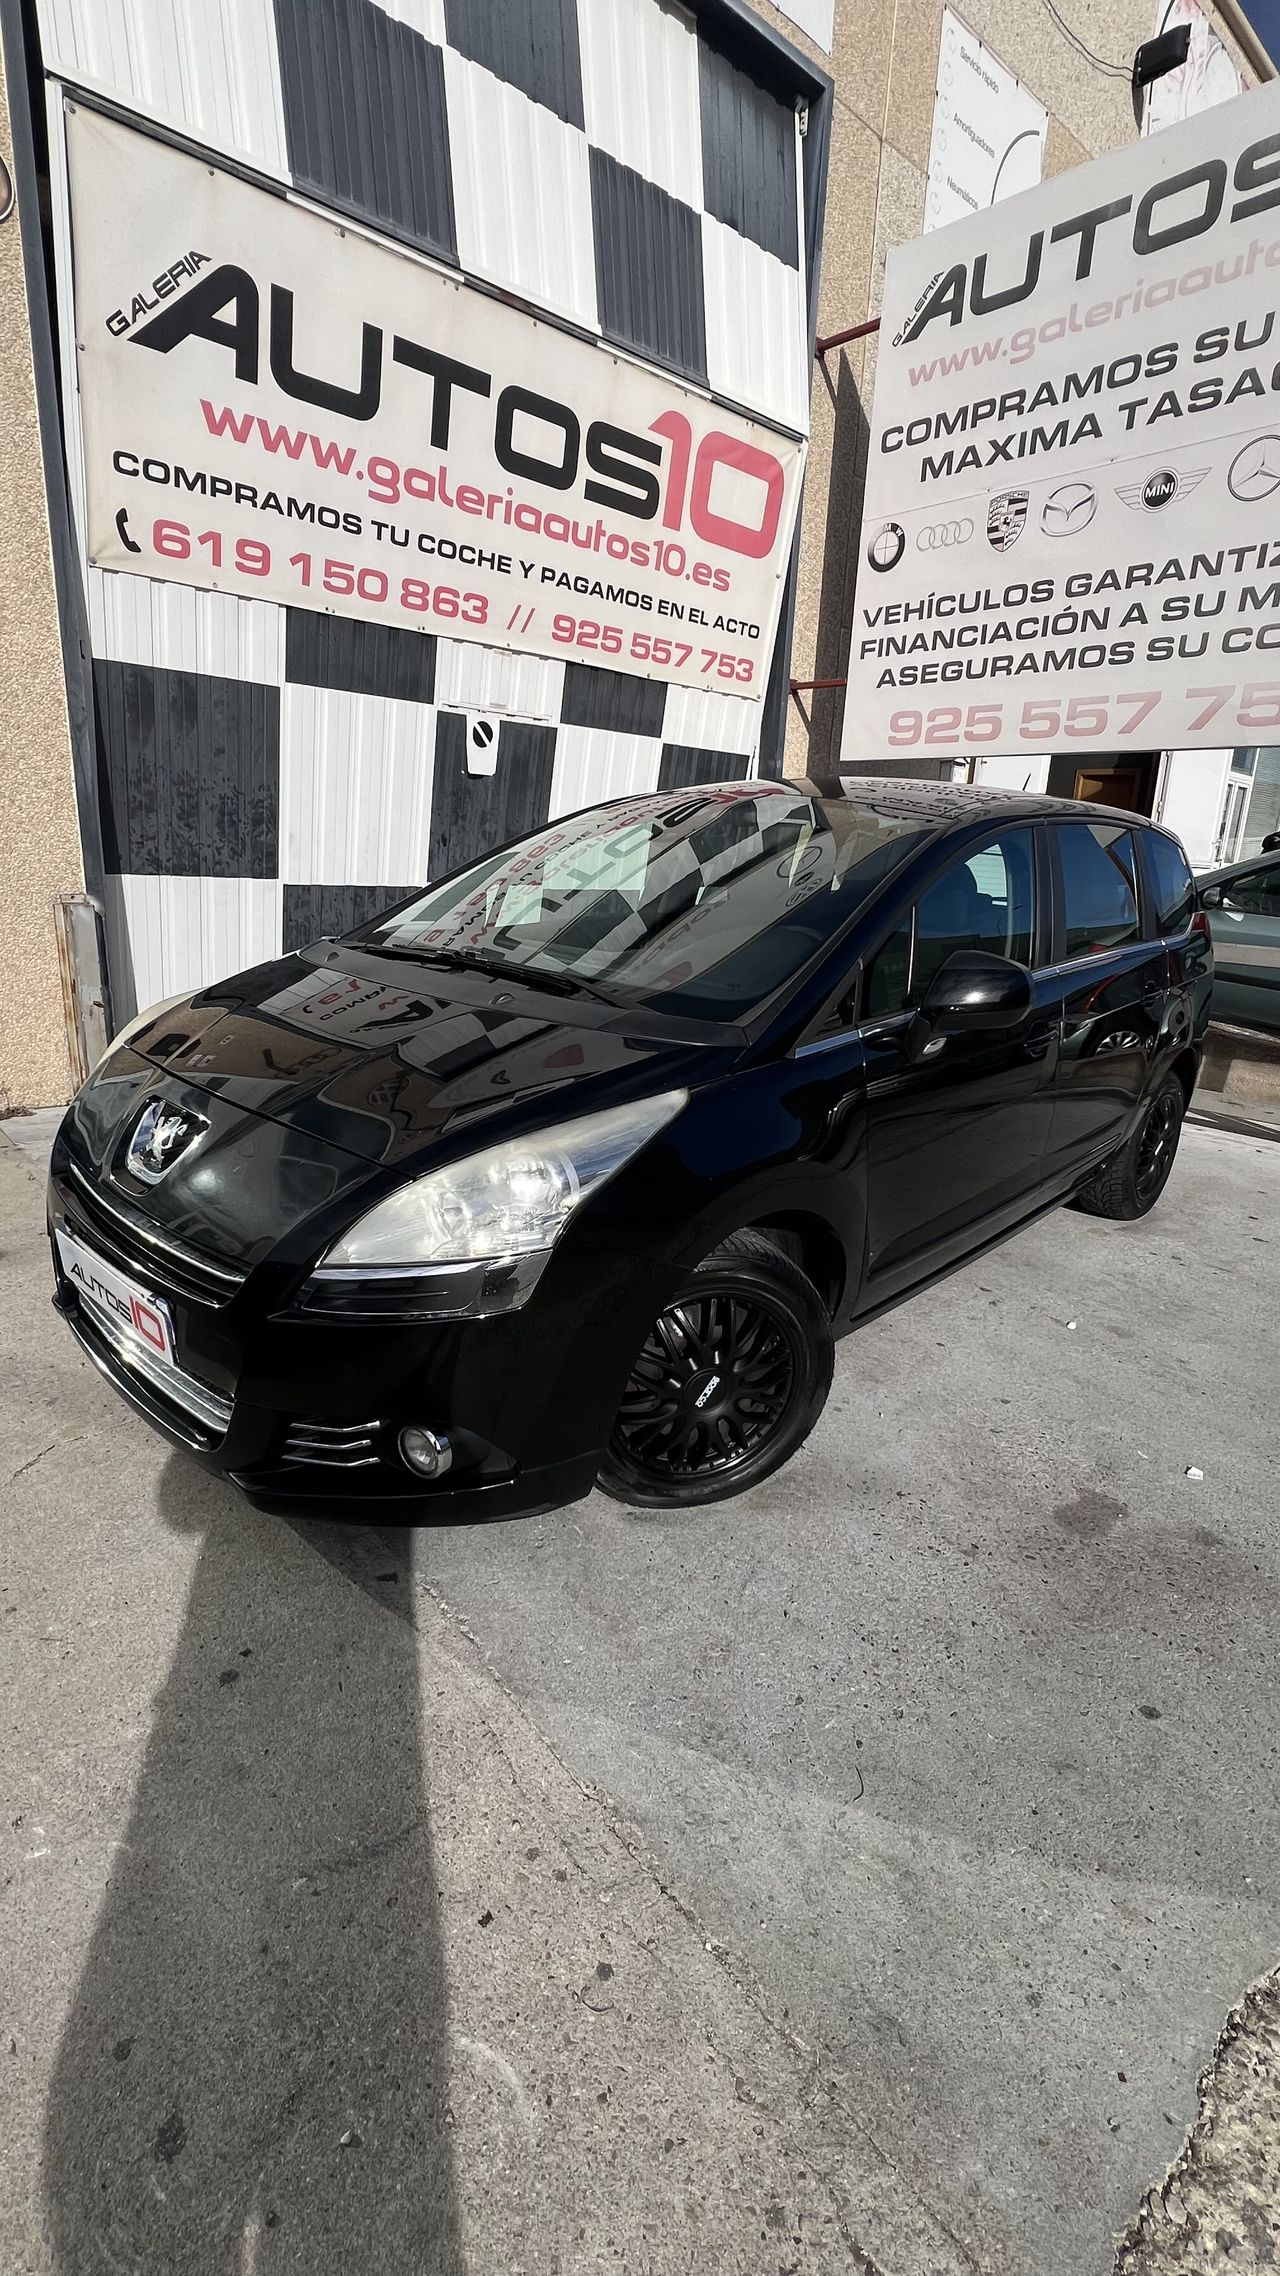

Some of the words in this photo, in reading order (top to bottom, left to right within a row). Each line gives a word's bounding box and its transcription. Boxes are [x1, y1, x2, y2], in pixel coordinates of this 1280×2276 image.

[953, 112, 996, 158] Amortiguadores
[105, 249, 212, 337] GALERIA
[891, 271, 945, 349] GALERIA
[126, 264, 785, 559] AUTOS10
[881, 341, 1179, 454] COMPRAMOS
[1193, 310, 1277, 364] SU
[920, 412, 1104, 483] MAXIMA
[1118, 360, 1280, 432] TASA
[199, 398, 731, 592] www.galeriaautos10.es
[1144, 481, 1175, 499] MINI
[112, 450, 363, 535] COMPRAMOS
[371, 519, 410, 547] TU
[417, 534, 512, 575] COCHE
[519, 559, 536, 580] Y
[540, 567, 653, 611] PAGAMOS
[657, 600, 685, 621] EN
[688, 607, 709, 627] EL
[712, 614, 761, 640] ACTO
[152, 518, 272, 576] 619
[289, 552, 389, 603] 150
[399, 577, 489, 625] 863
[551, 614, 623, 655] 925
[630, 634, 693, 668] 557
[700, 647, 755, 683] 753
[859, 605, 1111, 660] FINANCIACIÓN
[1119, 602, 1149, 629] A
[1161, 590, 1227, 622] SU
[862, 579, 1055, 629] VEHÍCULOS
[876, 641, 1135, 689] ASEGURAMOS
[1146, 631, 1210, 662] SU
[887, 704, 1005, 747] 925
[1019, 692, 1162, 740] 557
[1186, 680, 1280, 731] 75
